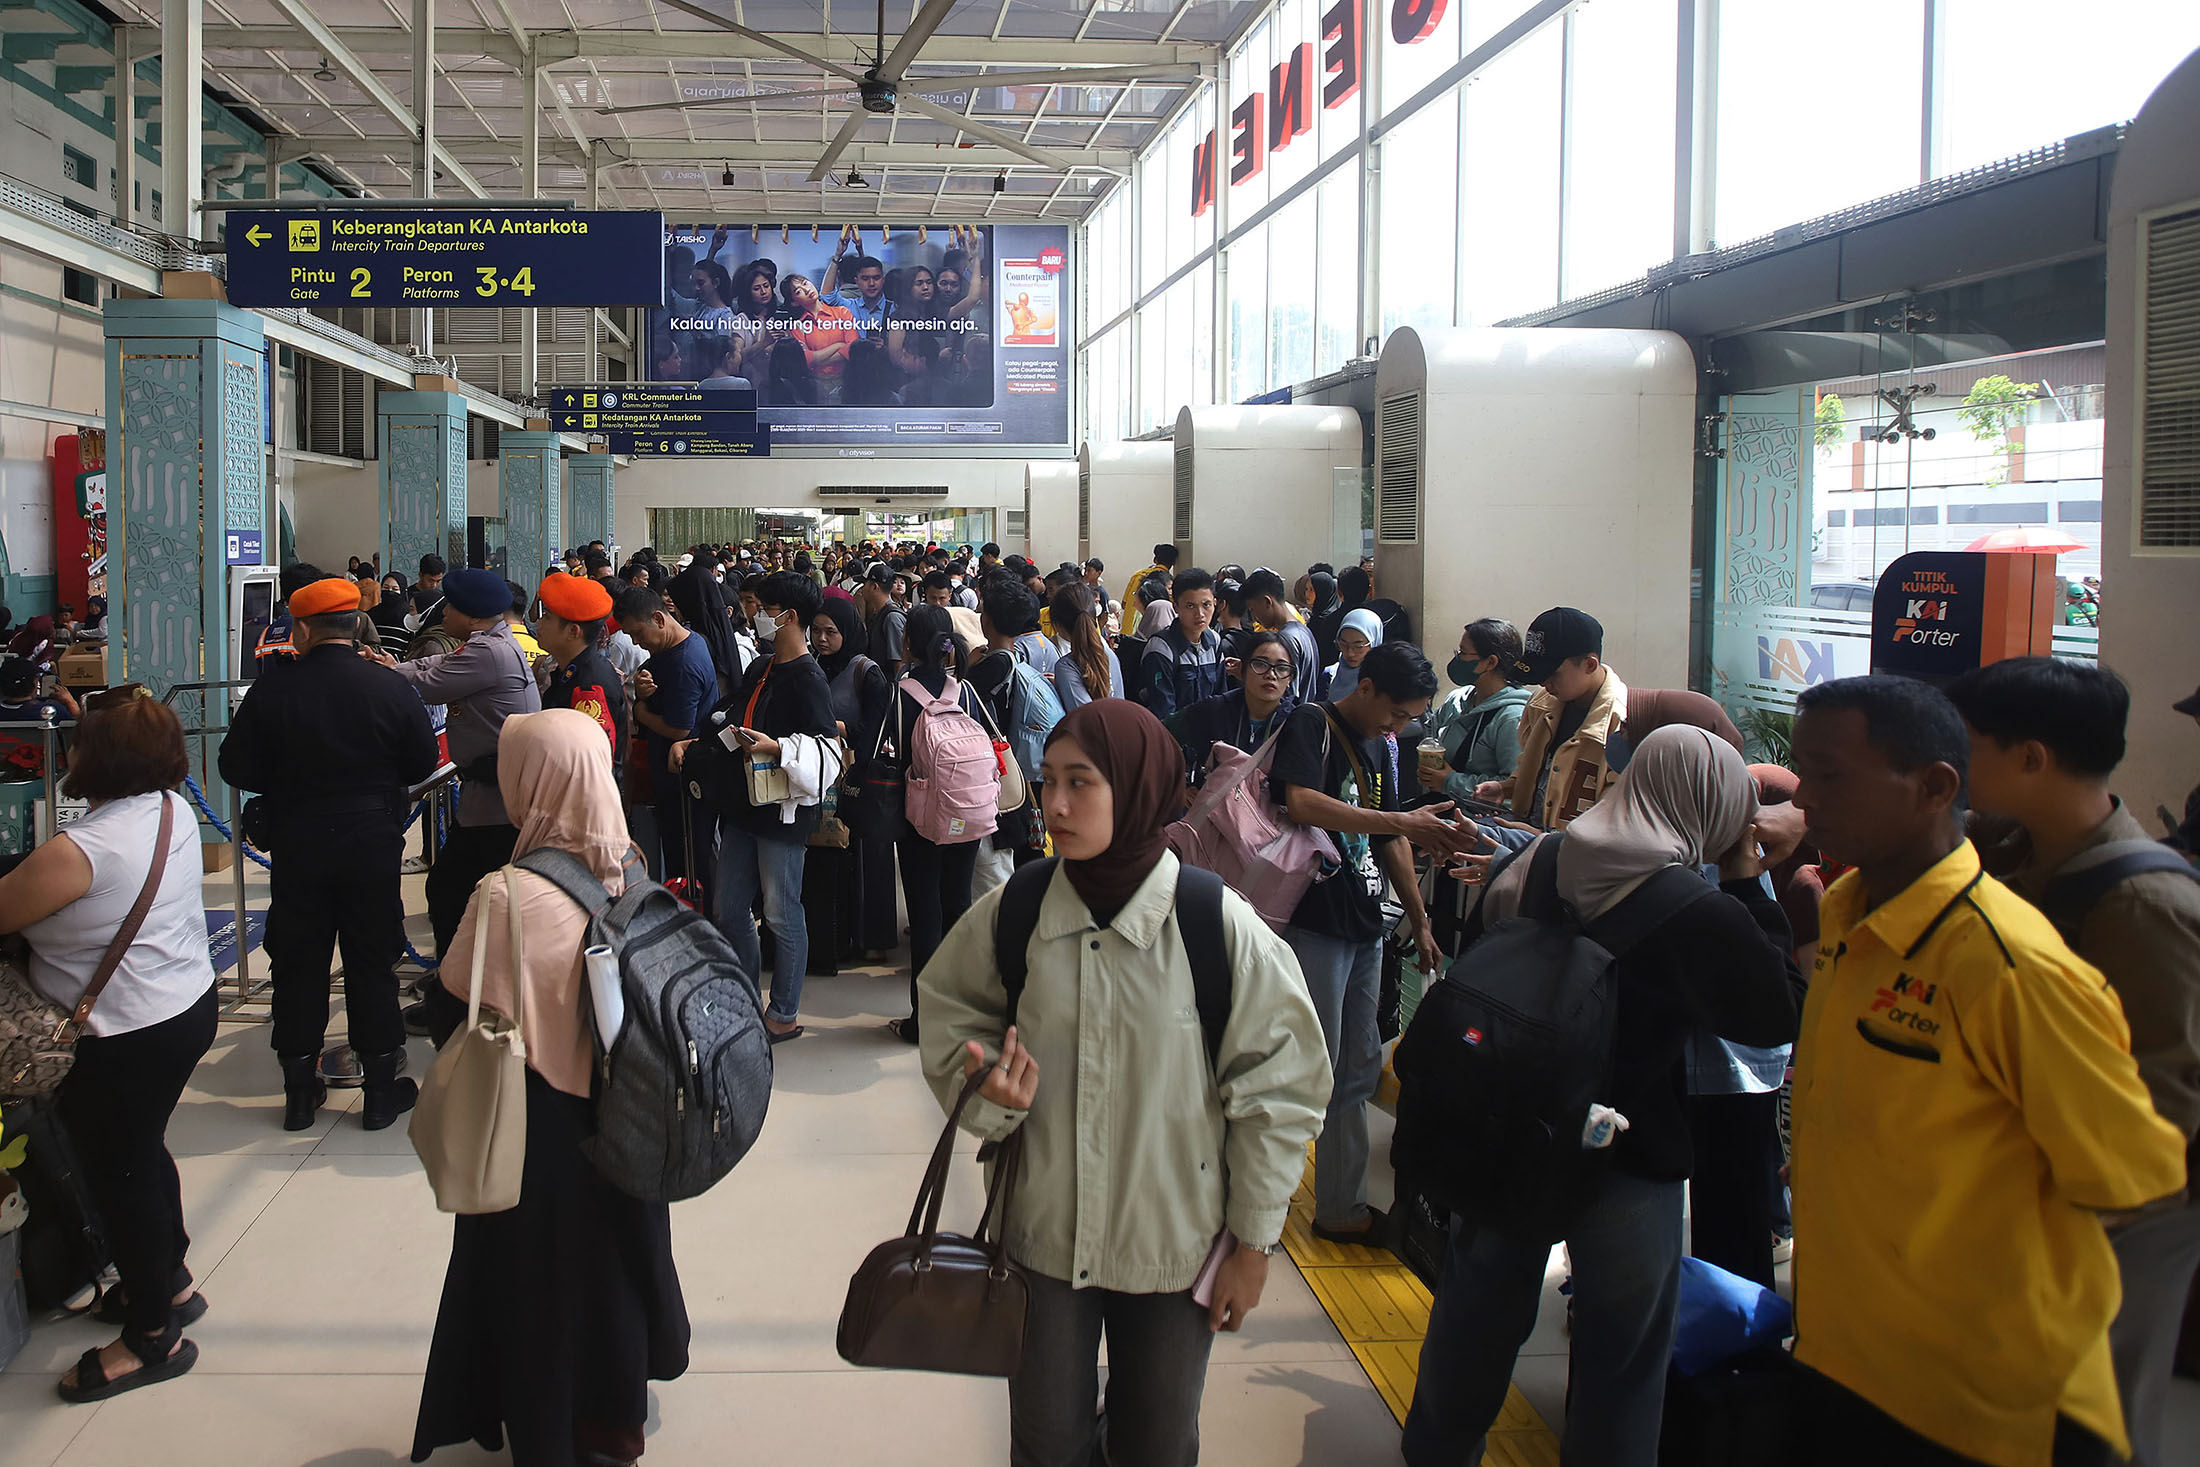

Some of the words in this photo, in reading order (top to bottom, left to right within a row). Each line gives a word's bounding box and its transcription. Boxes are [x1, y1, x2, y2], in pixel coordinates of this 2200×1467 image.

[331, 218, 464, 238] Keberangkatan
[470, 218, 496, 234] KA
[500, 218, 588, 234] Antarkota
[675, 235, 706, 243] TAISHO
[331, 239, 381, 254] Intercity
[384, 239, 414, 252] Train
[417, 239, 485, 253] Departures
[1041, 255, 1062, 265] BARU
[290, 267, 336, 283] Pintu
[350, 267, 371, 298] 2
[403, 266, 453, 282] Peron
[1005, 271, 1053, 282] Counterpain
[290, 287, 320, 300] Gate
[402, 286, 460, 300] Platforms
[671, 317, 715, 331] Kalau
[718, 317, 762, 334] hidup
[766, 317, 812, 334] sering
[817, 317, 883, 333] tertekuk,
[886, 317, 947, 331] lemesin
[950, 317, 978, 334] aja.
[622, 393, 639, 401] KRL
[640, 393, 683, 401] Commuter
[685, 393, 702, 401] Line
[602, 414, 648, 422] Kedatangan
[663, 413, 702, 421] Antarkota
[659, 440, 669, 453] 6
[1912, 571, 1948, 583] TITIK
[1901, 582, 1959, 595] KUMPUL
[1892, 618, 1960, 648] Porter
[1871, 987, 1941, 1036] Porter
